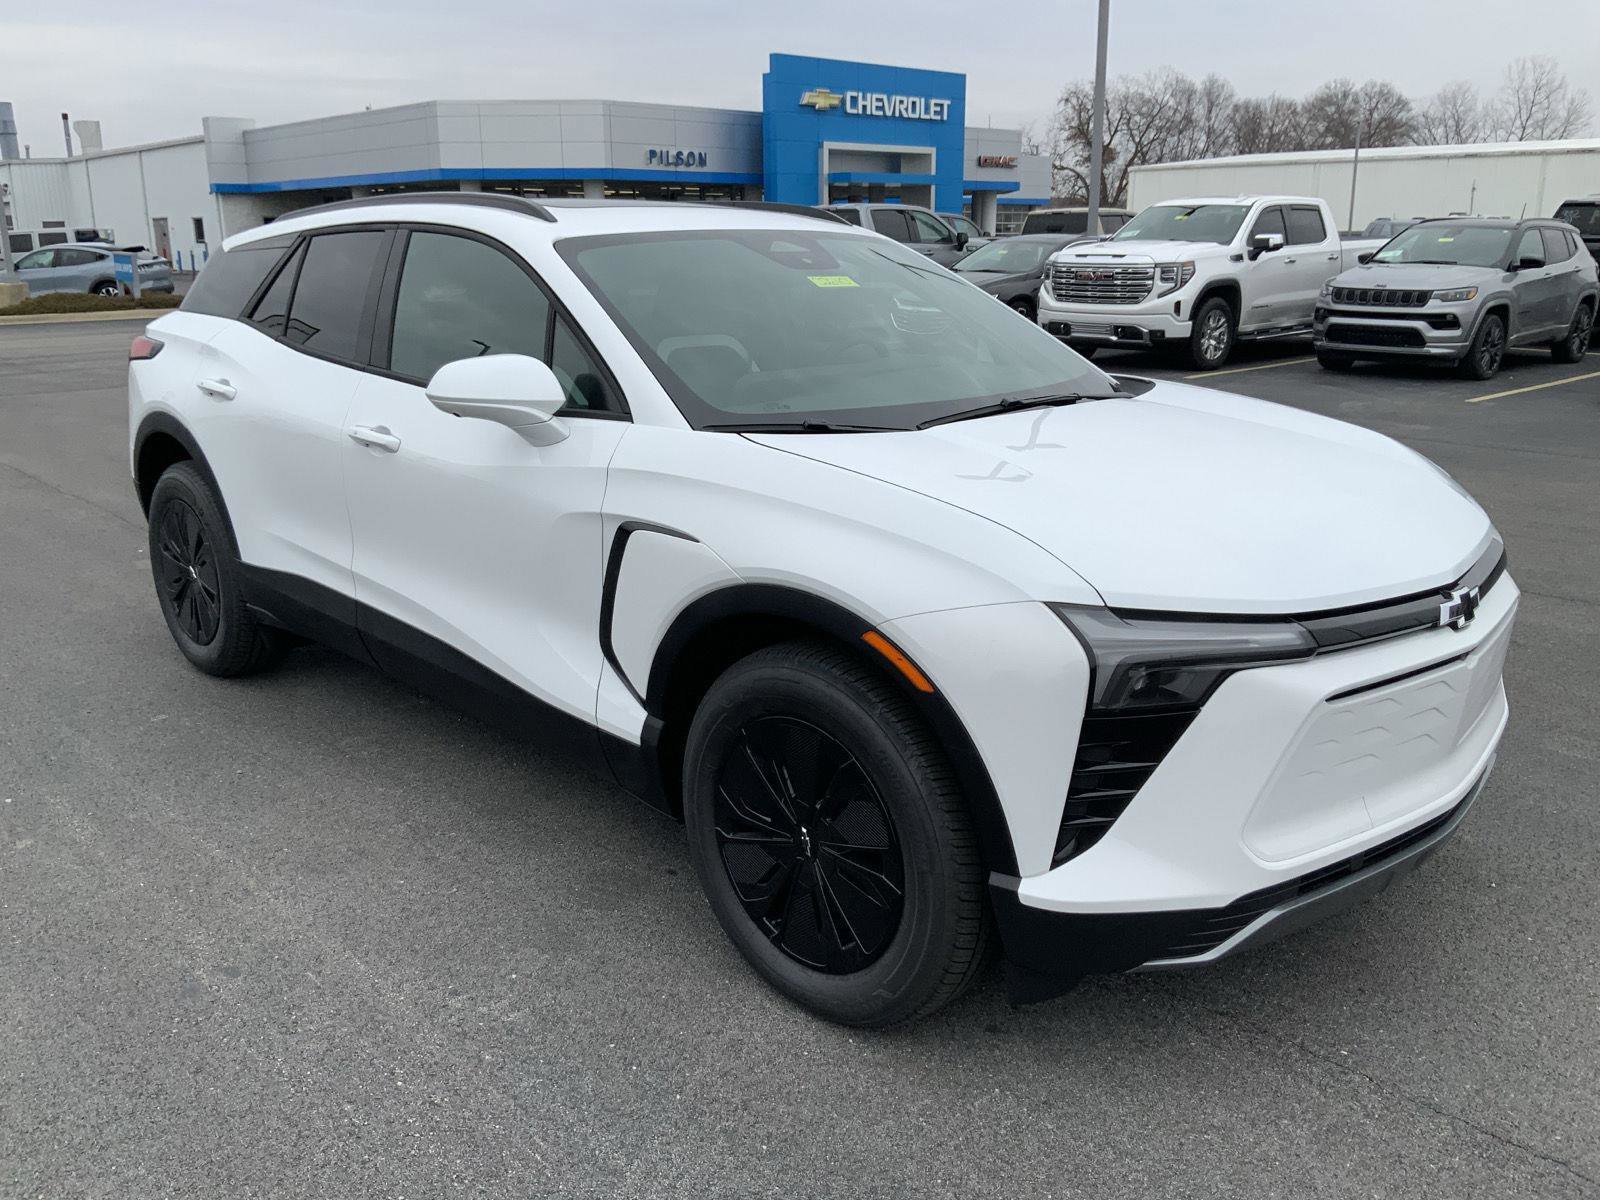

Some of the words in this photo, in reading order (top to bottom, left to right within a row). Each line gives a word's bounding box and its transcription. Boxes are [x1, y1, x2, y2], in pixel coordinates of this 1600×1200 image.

[845, 90, 951, 121] CHEVROLET
[648, 149, 707, 167] PILSON
[1076, 271, 1113, 281] GMC
